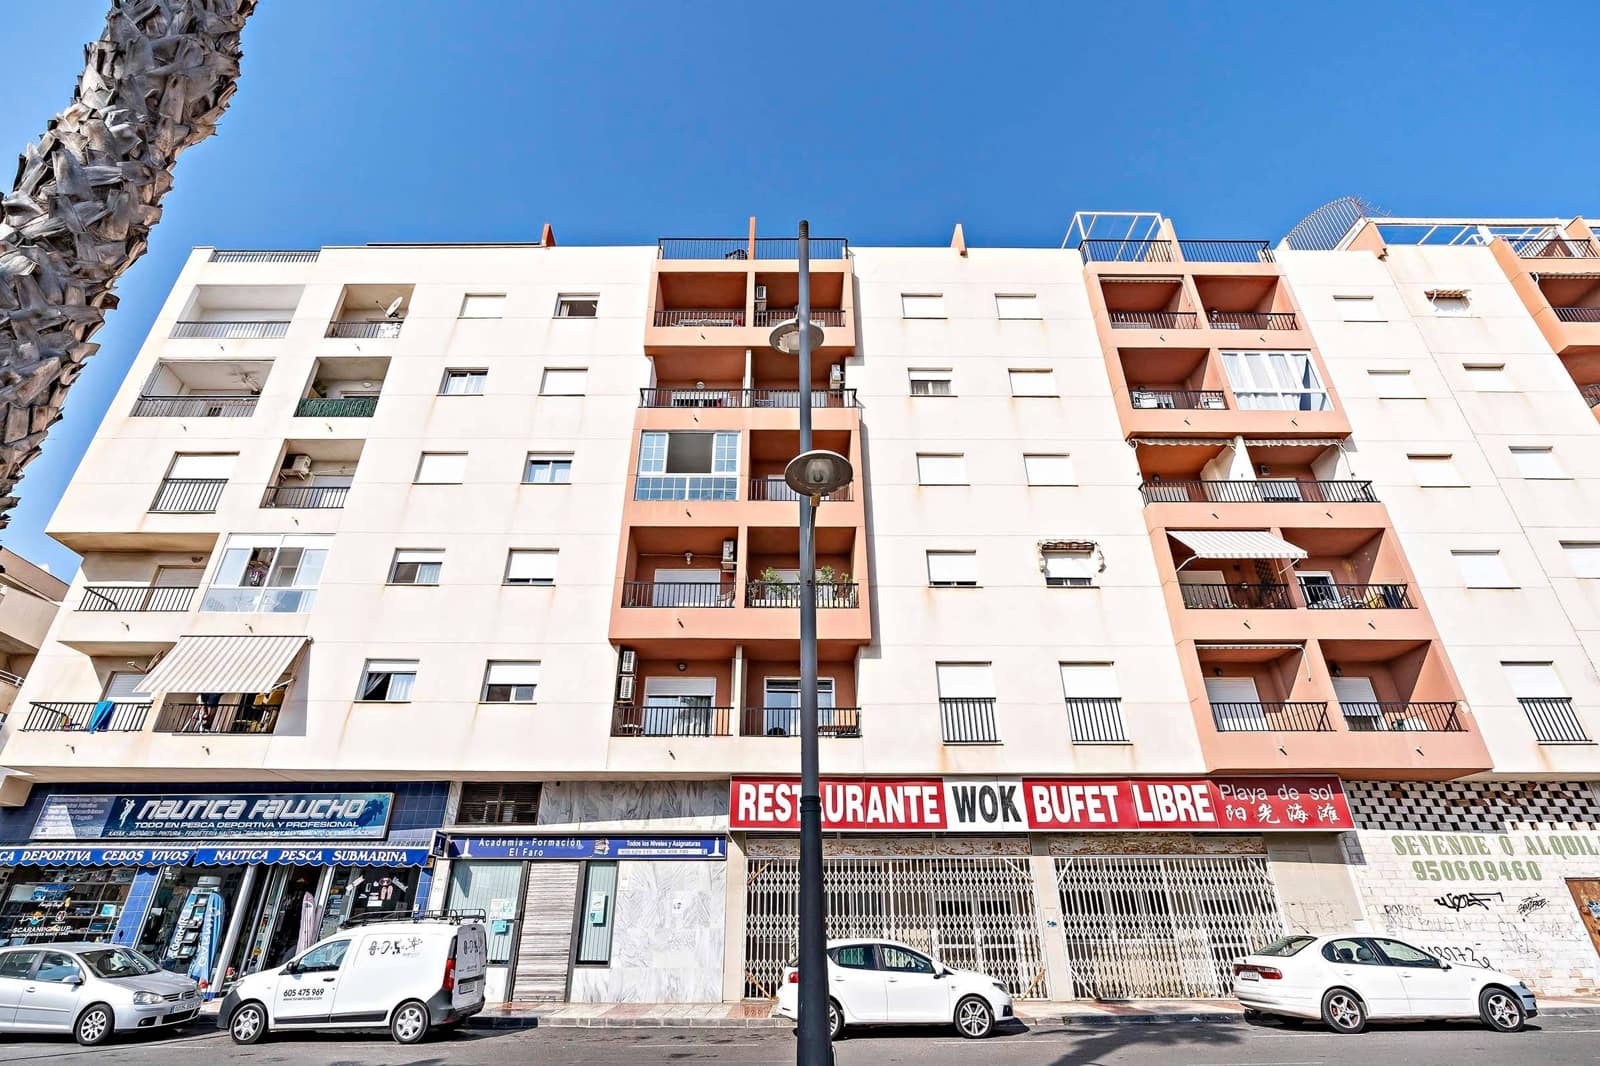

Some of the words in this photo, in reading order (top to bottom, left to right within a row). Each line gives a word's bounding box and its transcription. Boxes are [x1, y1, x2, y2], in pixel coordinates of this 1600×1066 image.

[1219, 784, 1268, 804] Playa
[1277, 784, 1299, 800] de
[1309, 784, 1334, 800] sol
[951, 784, 1022, 823] WOK
[1031, 784, 1119, 823] BUFET
[1131, 784, 1216, 822] LIBRE
[135, 821, 165, 829] TODO
[164, 821, 181, 829] EN
[180, 821, 214, 829] PESCA
[478, 837, 523, 847] Academia
[531, 837, 582, 847] Formación
[626, 839, 641, 847] Todos
[642, 839, 650, 847] los
[650, 839, 668, 847] Niveles
[672, 839, 701, 848] Asignaturas
[1524, 835, 1600, 860] ALQUIL
[20, 850, 92, 861] DEPORTIVA
[101, 850, 145, 861] CEBOS
[151, 850, 190, 861] VIVOS
[214, 850, 268, 861] NAUTICA
[279, 850, 323, 861] PESCA
[332, 850, 408, 862] SUBMARINA
[509, 848, 518, 857] El
[522, 848, 544, 857] Faro
[1411, 860, 1543, 881] 950609460
[283, 989, 297, 997] 605
[297, 988, 311, 996] 475
[311, 988, 325, 996] 969
